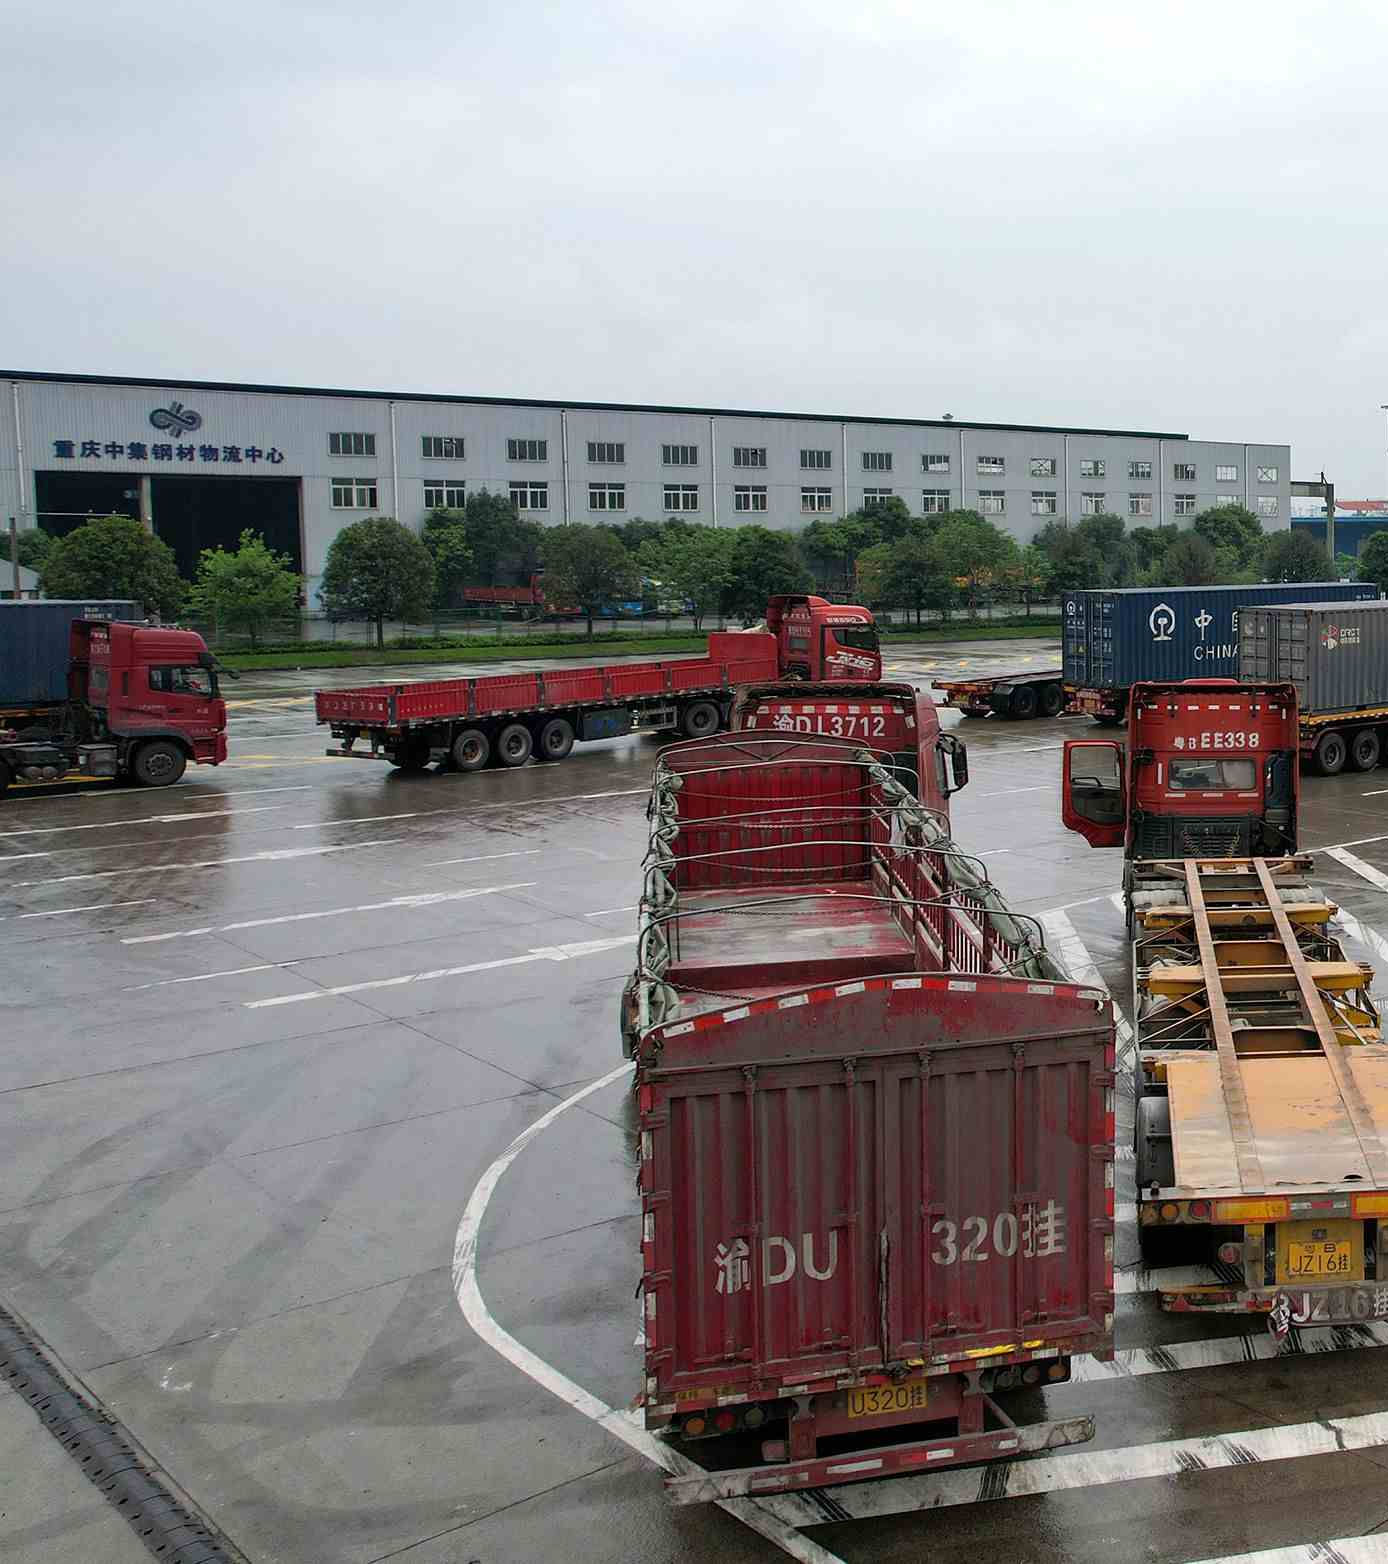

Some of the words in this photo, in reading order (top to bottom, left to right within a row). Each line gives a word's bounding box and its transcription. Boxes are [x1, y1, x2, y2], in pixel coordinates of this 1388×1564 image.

[52, 440, 285, 464] 重庆中集钢材物流中心
